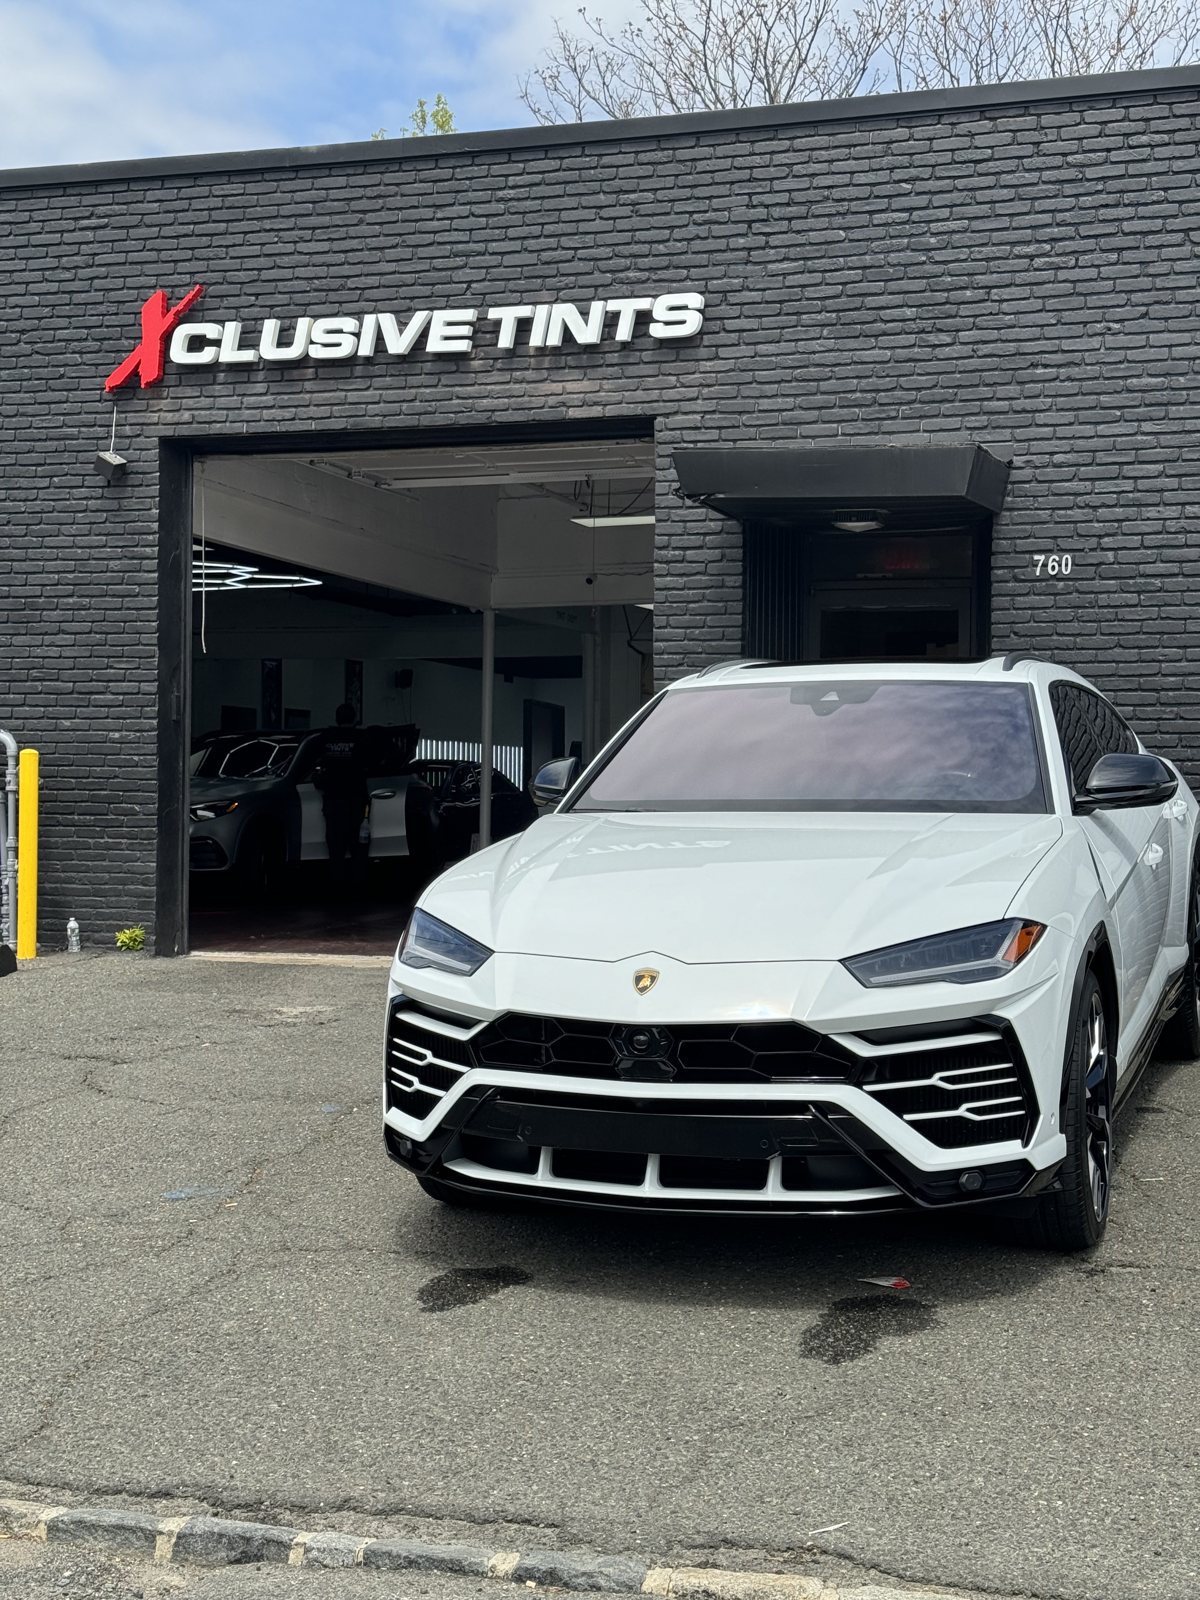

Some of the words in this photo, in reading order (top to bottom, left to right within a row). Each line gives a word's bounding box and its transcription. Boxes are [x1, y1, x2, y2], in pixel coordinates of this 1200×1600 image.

[105, 284, 478, 393] XCLUSIVE
[487, 292, 705, 349] TINTS
[1033, 554, 1072, 576] 760
